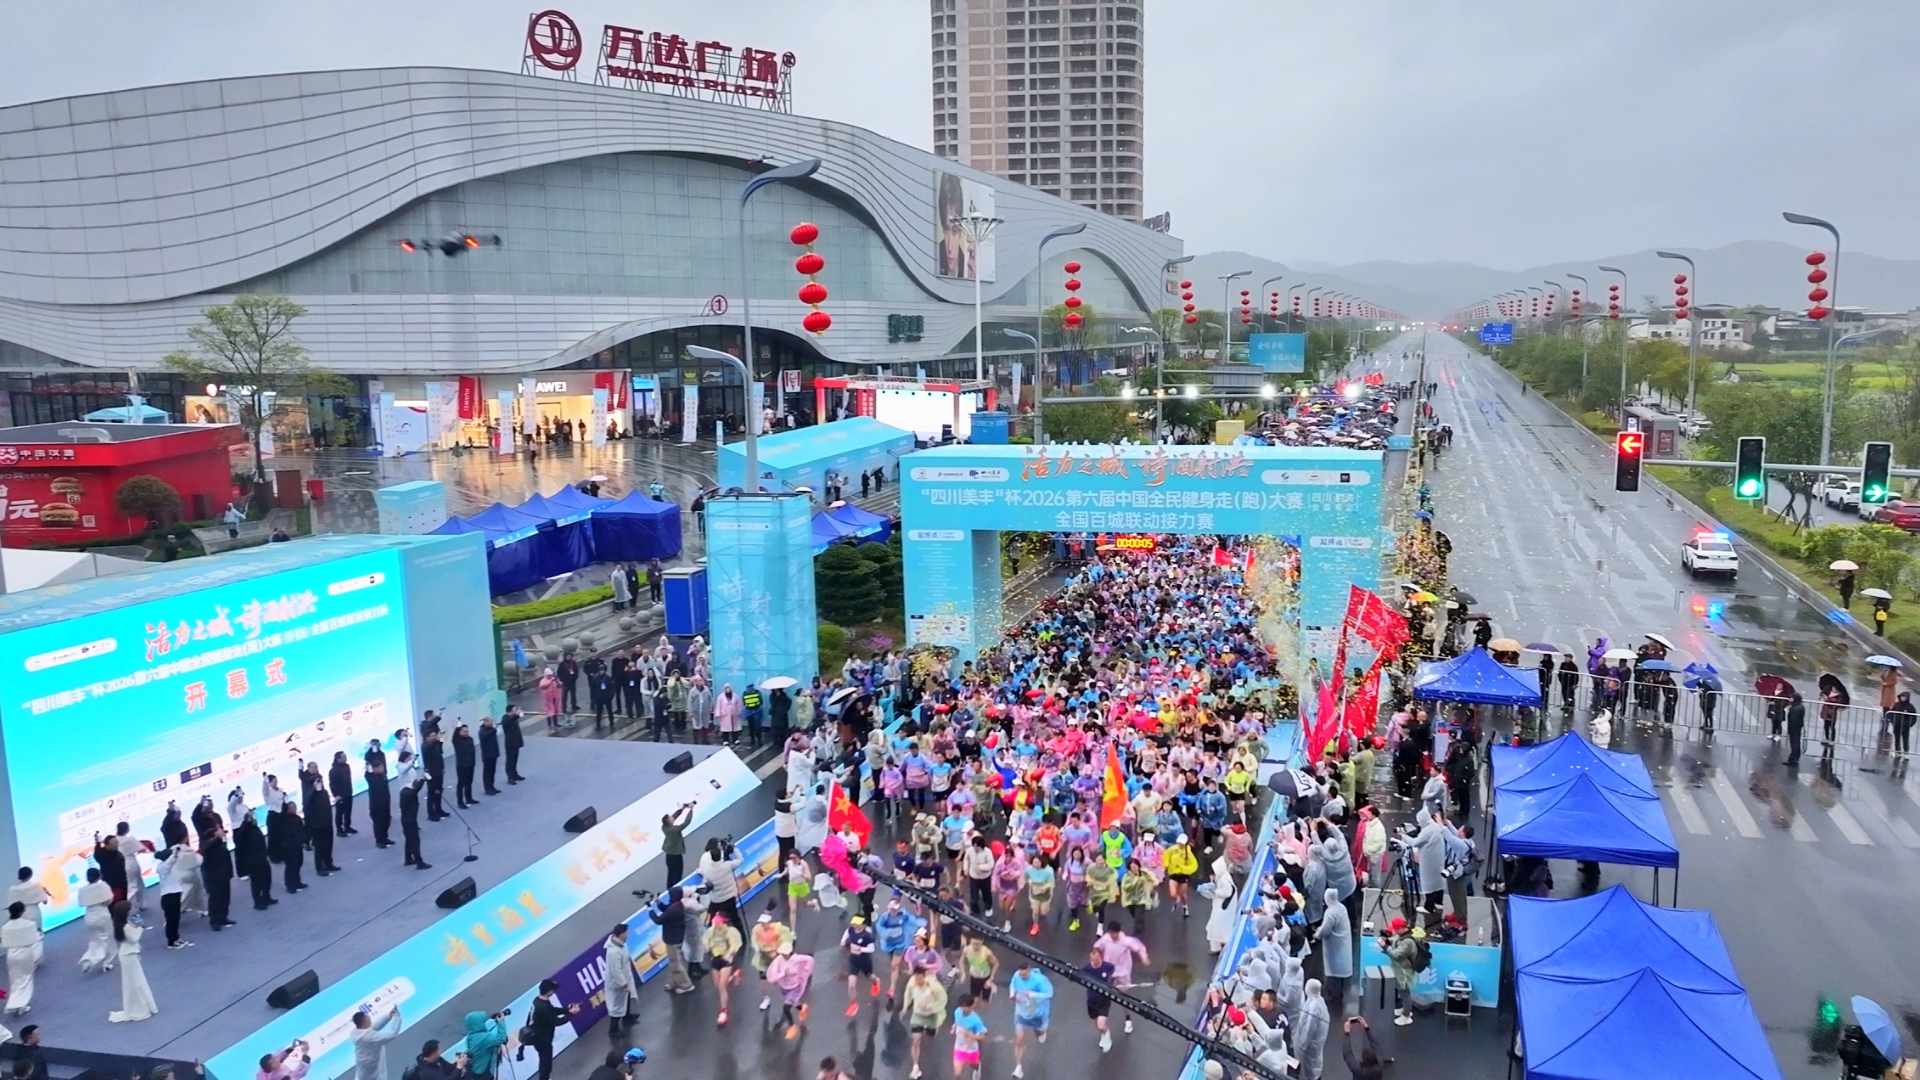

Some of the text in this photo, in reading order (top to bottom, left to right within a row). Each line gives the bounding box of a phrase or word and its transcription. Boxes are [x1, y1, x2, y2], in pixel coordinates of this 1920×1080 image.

[603, 25, 778, 83] 万达广场
[606, 64, 778, 100] WANDA PLAZA
[517, 381, 567, 394] HAWEI
[1054, 511, 1215, 531] 全国百城联动接力赛
[184, 657, 287, 714] 开幕式
[576, 954, 607, 995] HLA
